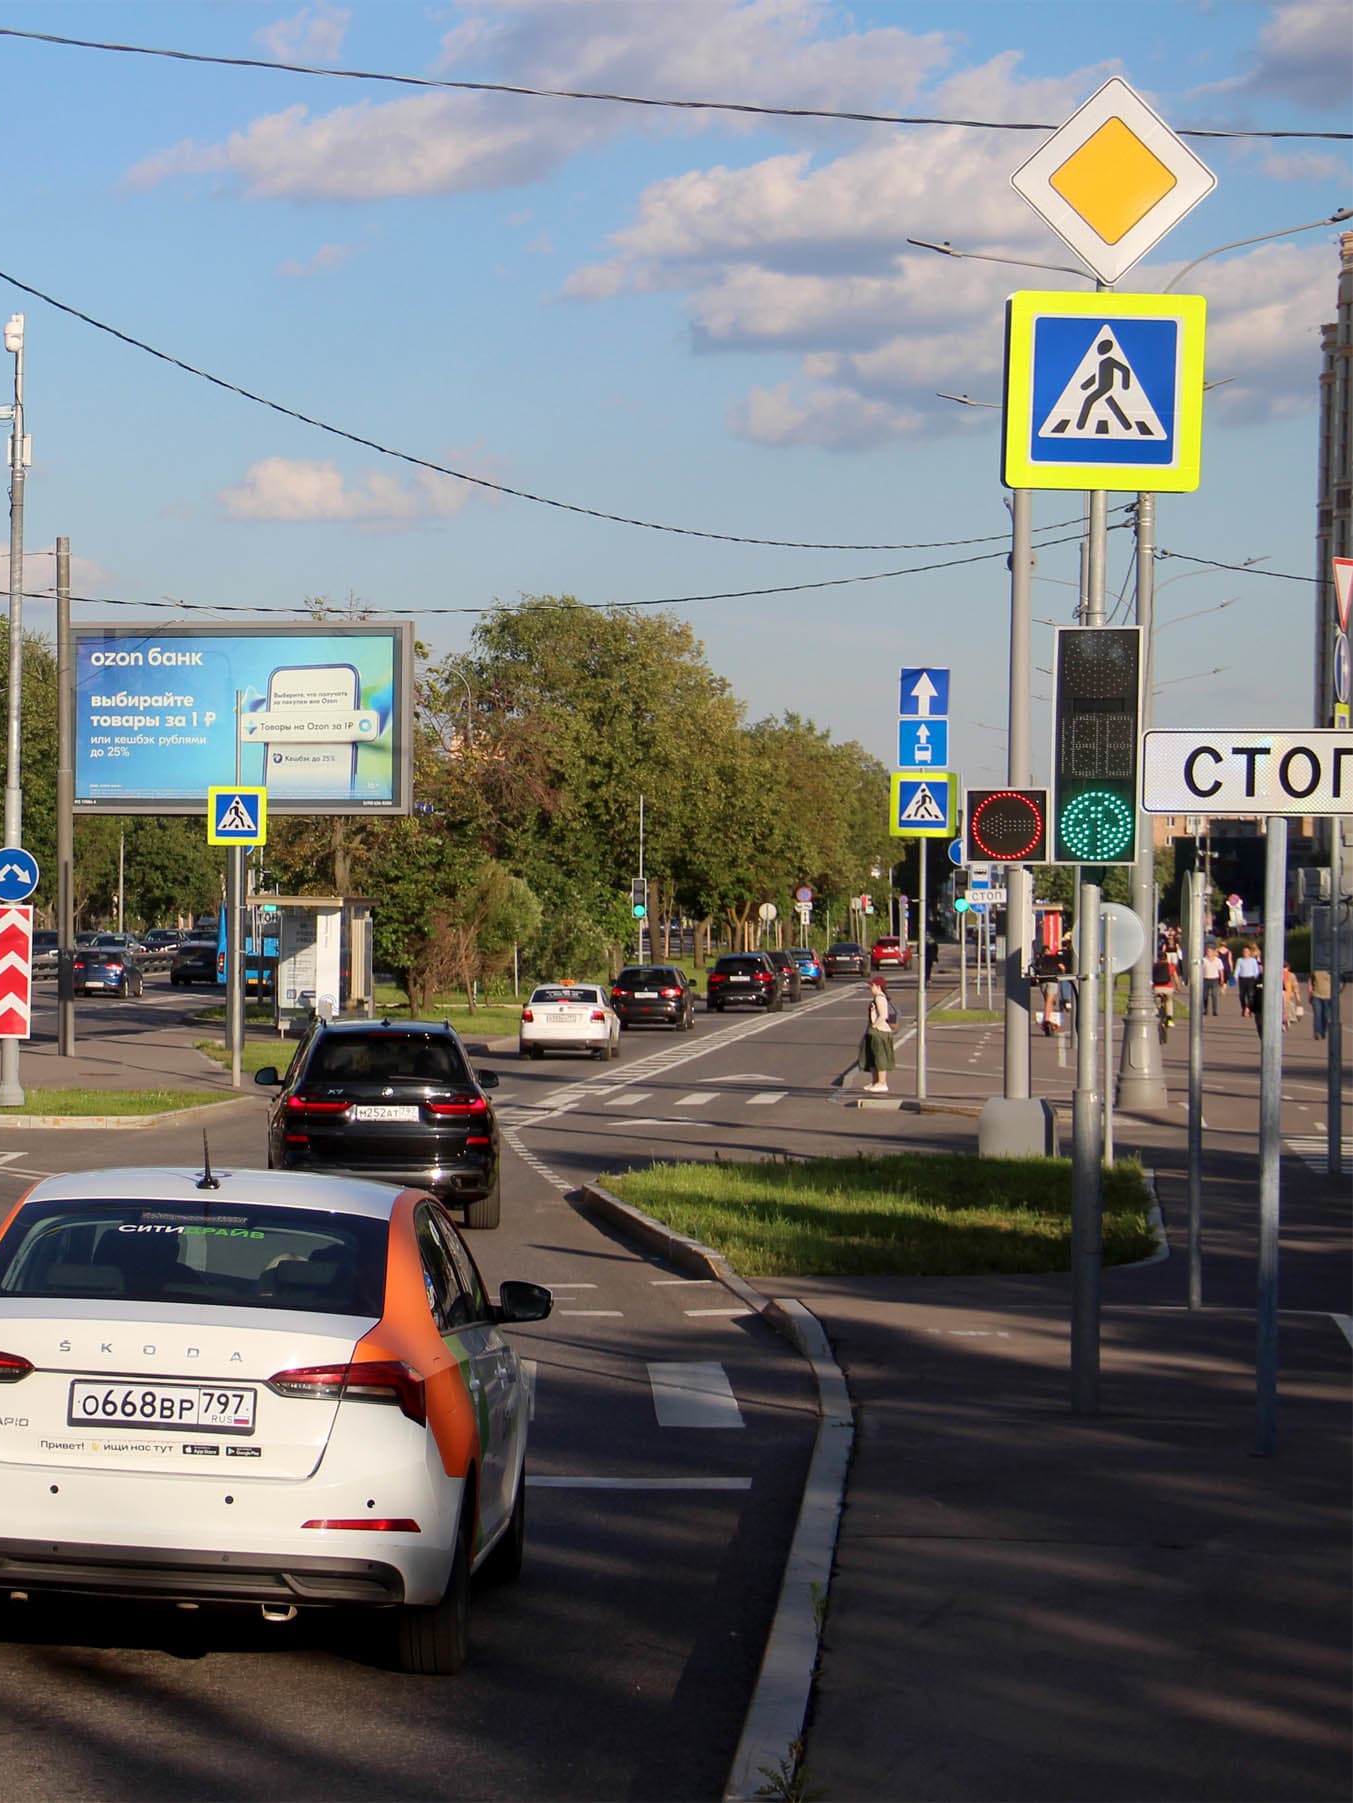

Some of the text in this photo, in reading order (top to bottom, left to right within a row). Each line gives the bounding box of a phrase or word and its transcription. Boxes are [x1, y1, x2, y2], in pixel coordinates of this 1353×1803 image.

[90, 648, 204, 667] ozon банк
[91, 692, 194, 711] выбирайте
[90, 714, 160, 731] товары
[164, 714, 186, 728] за
[191, 712, 198, 727] 1
[260, 722, 292, 732] Товары
[294, 723, 305, 731] на
[307, 721, 329, 730] Ozon
[331, 723, 342, 731] за
[90, 733, 207, 747] или кешбэк рублями
[90, 746, 130, 759] до 25%
[284, 754, 310, 763] Кешбэк
[311, 755, 321, 764] до
[971, 891, 1002, 901] СТОП
[59, 1340, 243, 1363] ŠKODA
[82, 1389, 245, 1420] О668ВР 797
[210, 1414, 233, 1424] RUS
[40, 1440, 174, 1454] Привет! ищи нас тут
